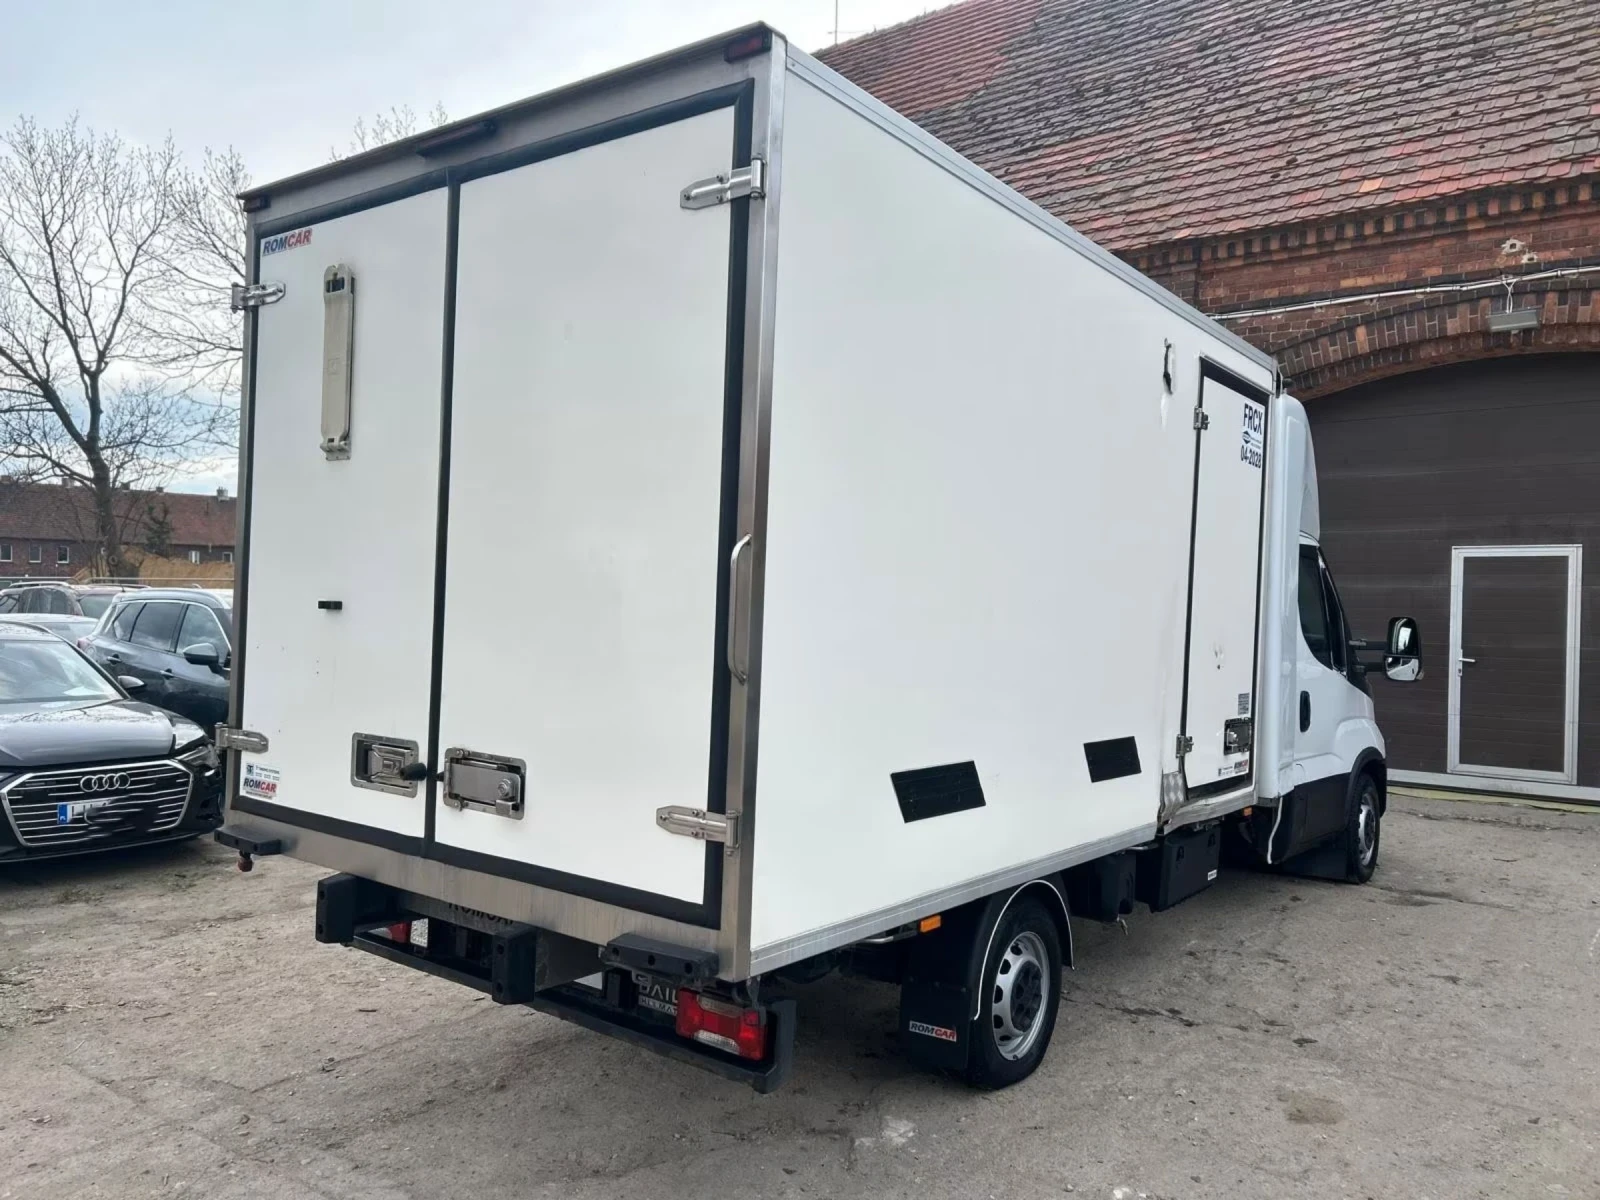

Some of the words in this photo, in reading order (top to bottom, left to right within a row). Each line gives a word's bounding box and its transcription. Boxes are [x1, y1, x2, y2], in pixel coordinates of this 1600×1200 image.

[263, 229, 312, 254] ROMCAR
[1243, 403, 1263, 435] FRCX
[1241, 444, 1261, 469] 04-2028
[243, 778, 277, 793] ROMCAR
[911, 1022, 956, 1040] ROMCAR
